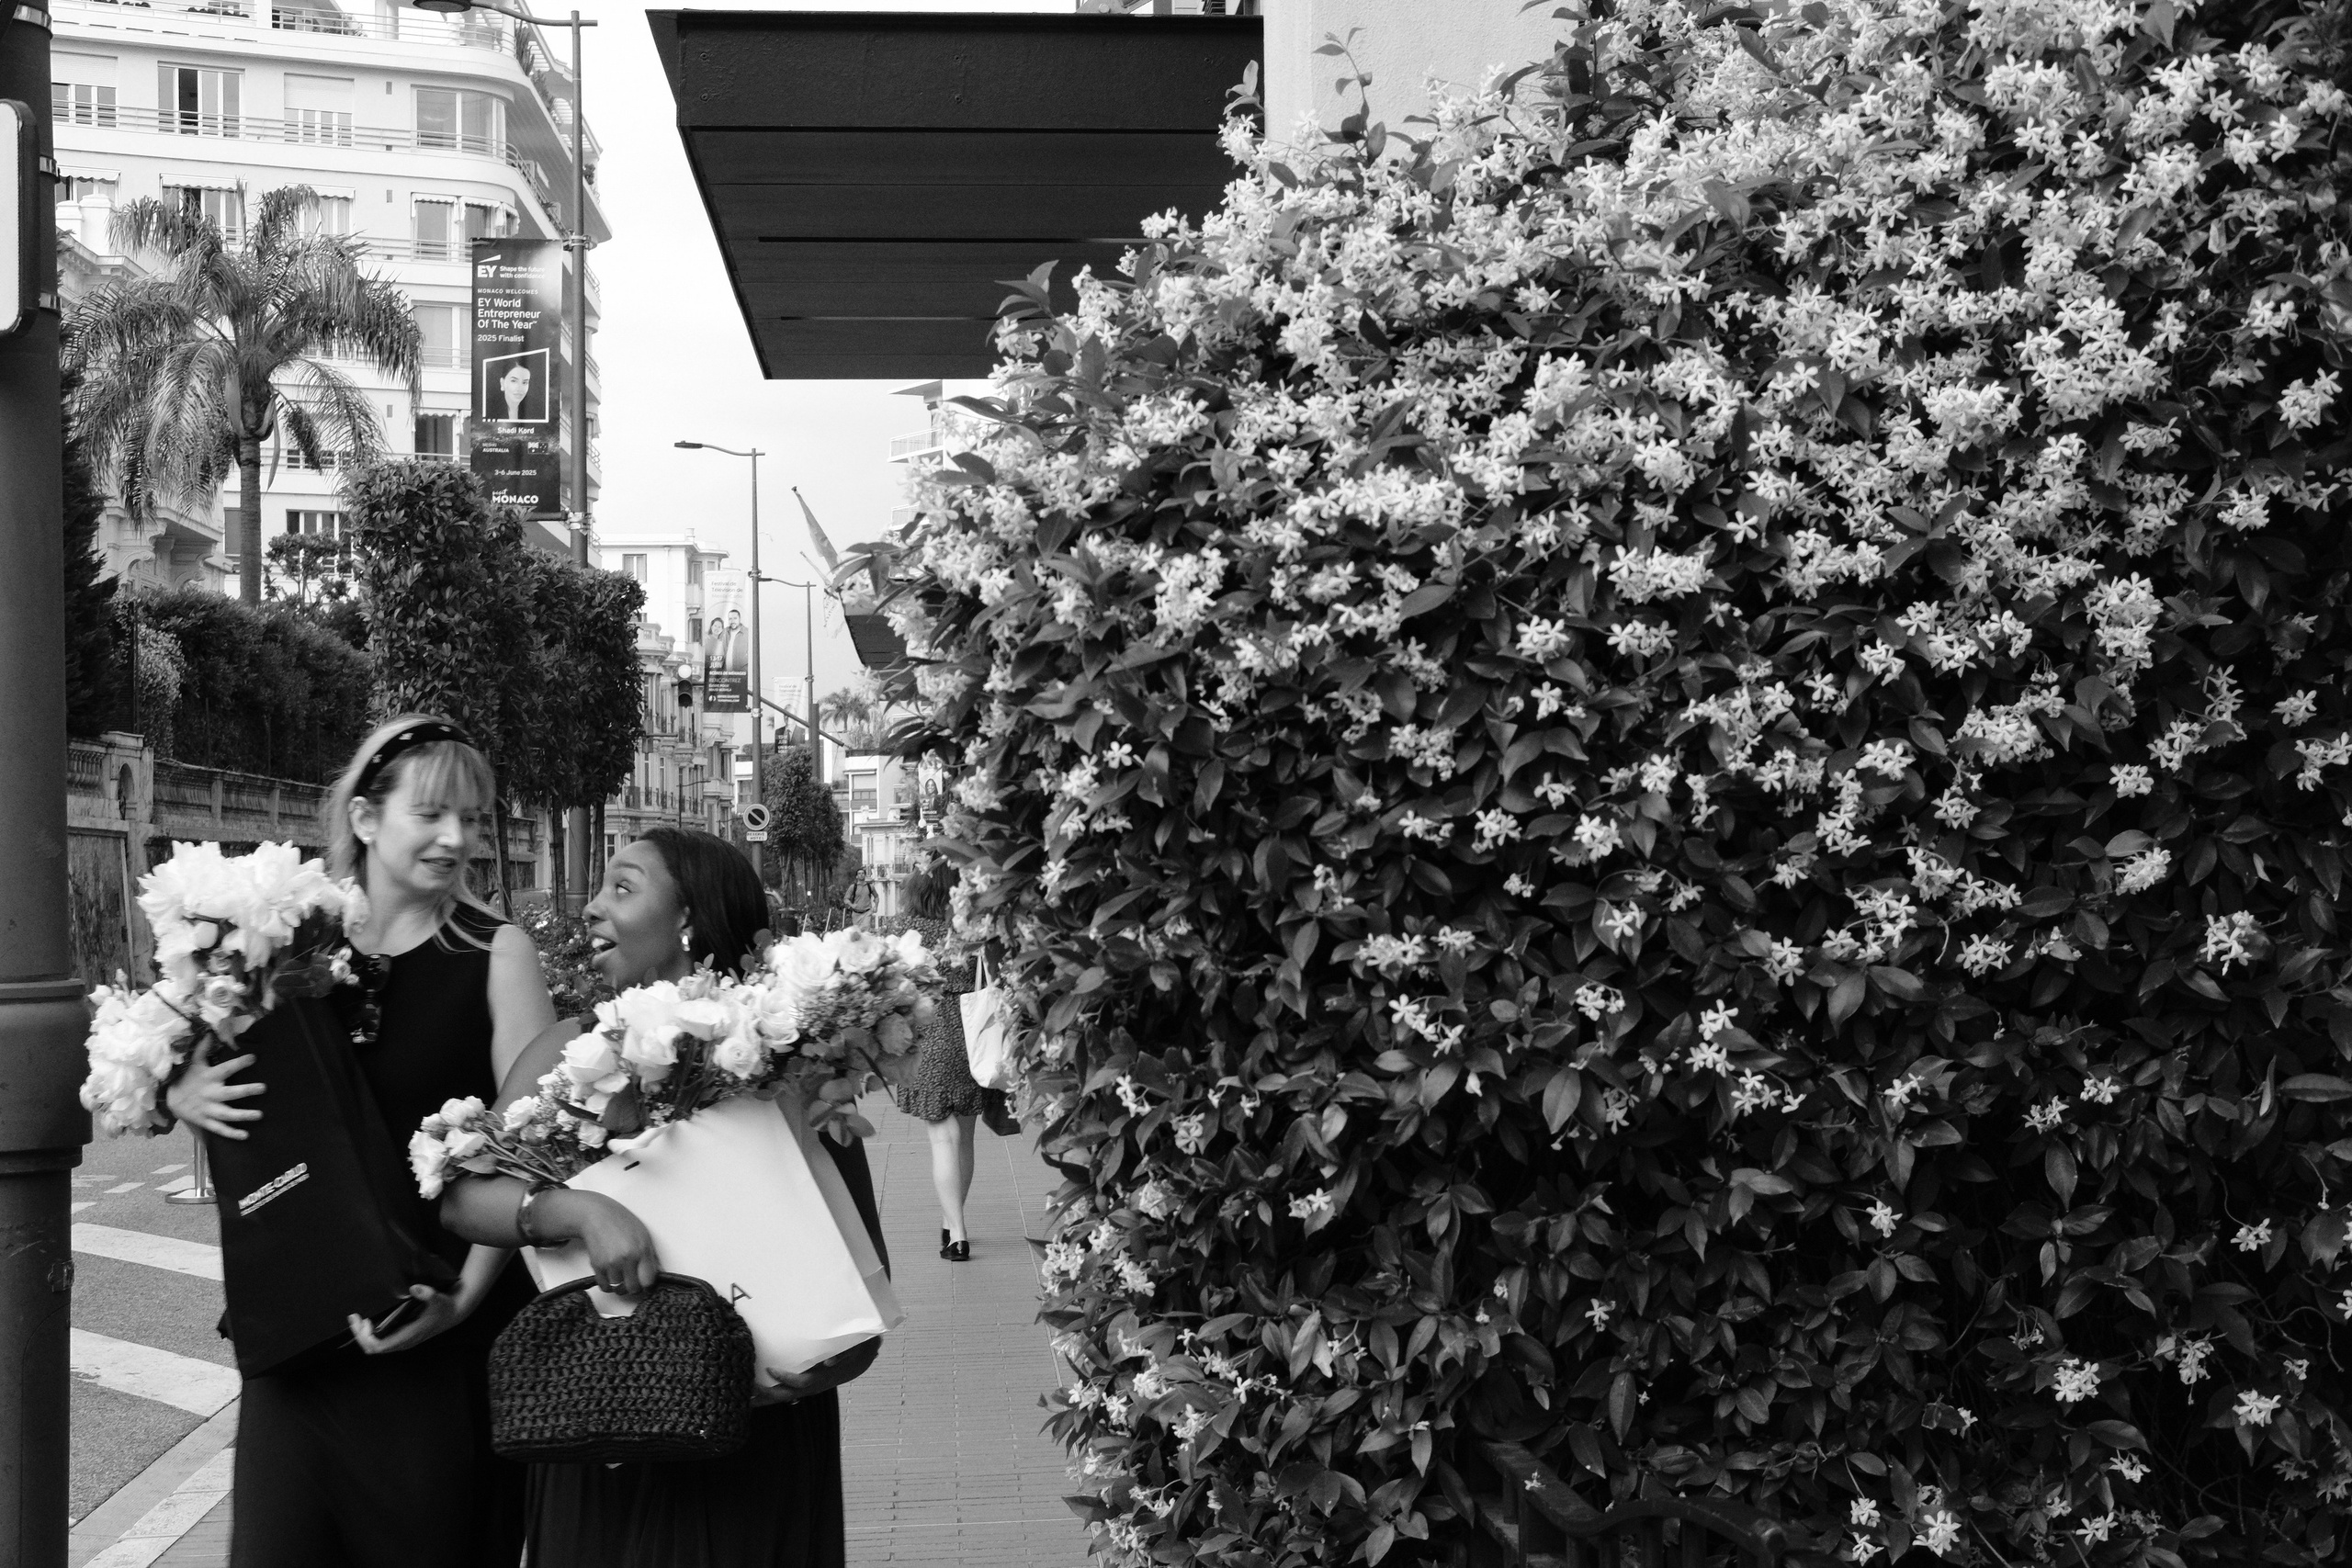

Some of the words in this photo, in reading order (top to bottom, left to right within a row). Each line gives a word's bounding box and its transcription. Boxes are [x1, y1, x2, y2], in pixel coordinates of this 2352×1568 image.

[478, 265, 497, 278] EY
[478, 298, 491, 307] EY
[494, 299, 521, 307] World
[478, 309, 541, 319] Entrepreneur
[478, 320, 490, 328] Of
[492, 320, 509, 328] The
[492, 495, 539, 504] MONACO
